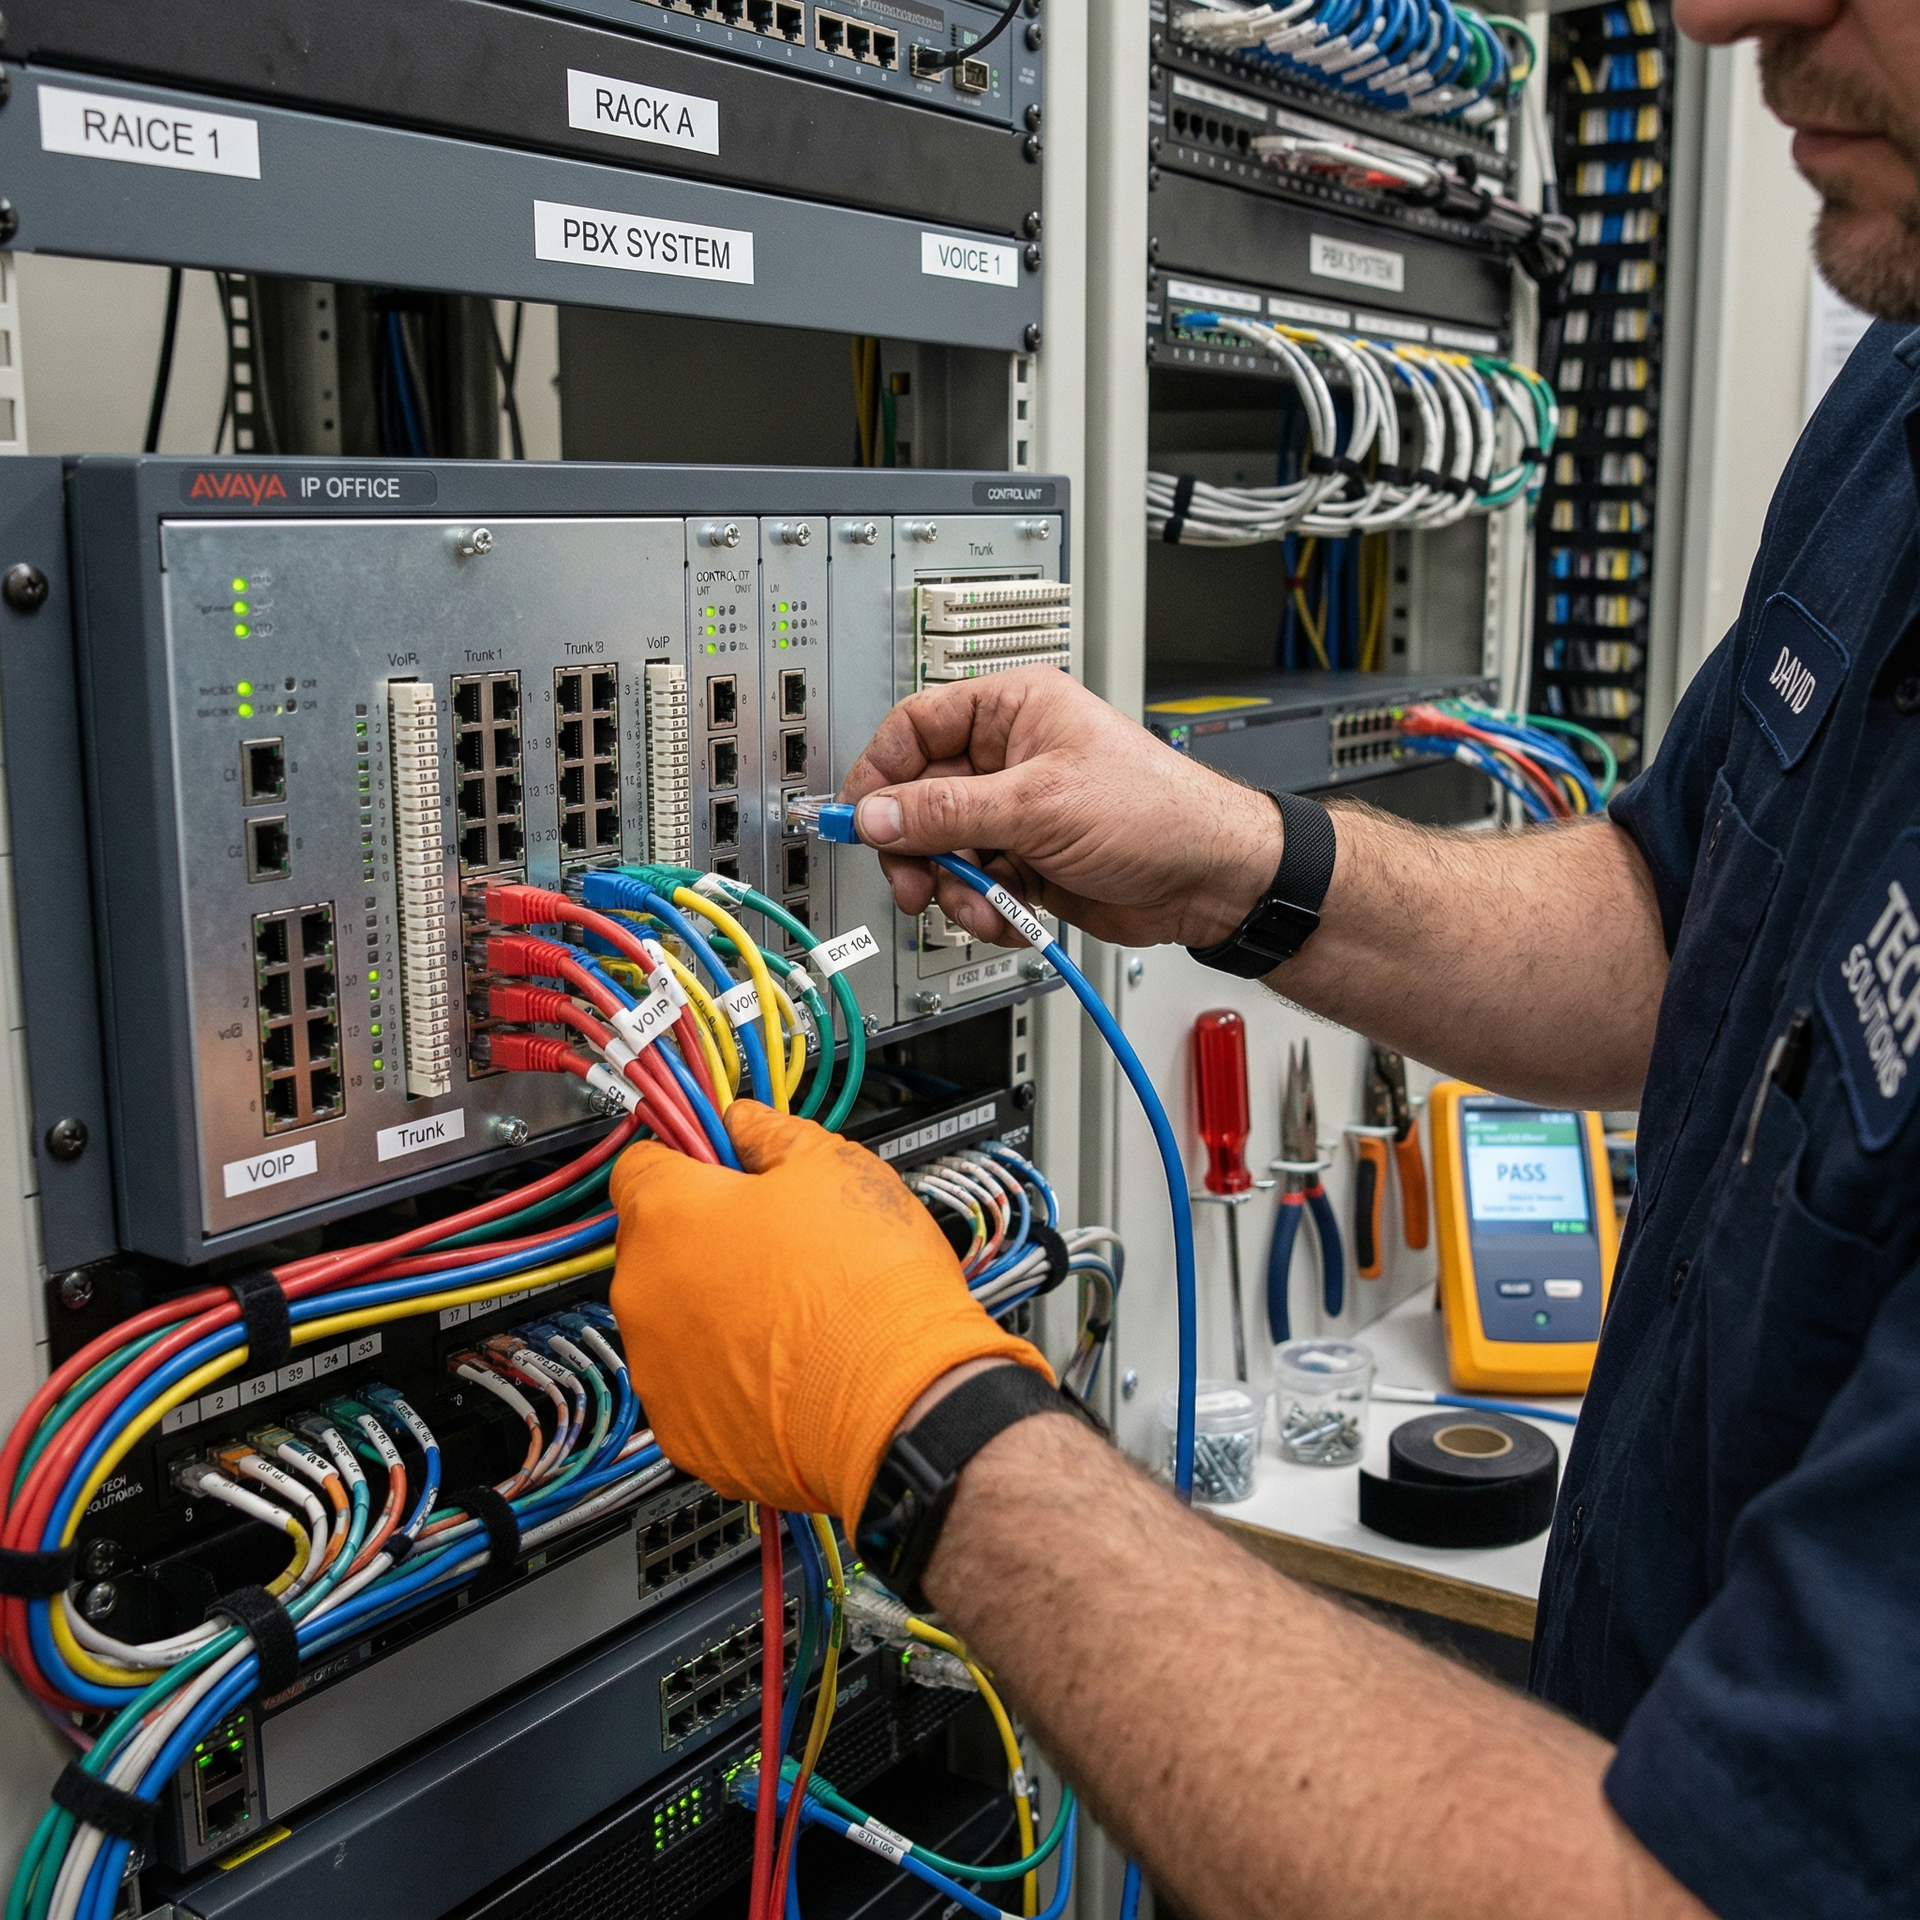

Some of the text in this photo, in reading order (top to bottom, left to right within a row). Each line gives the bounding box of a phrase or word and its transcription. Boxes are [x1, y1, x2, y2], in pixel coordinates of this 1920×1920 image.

[594, 88, 695, 138] RACK A
[83, 109, 220, 159] RAICE 1
[562, 217, 731, 271] PBX SYSTEM
[938, 244, 1002, 276] VOICE 1
[190, 472, 401, 506] AVAYA IP OFFICE
[968, 541, 994, 556] Trunk
[464, 648, 503, 663] Trunk 1
[563, 641, 595, 655] Trunk
[646, 635, 671, 649] VoIP
[1768, 645, 1817, 715] DAVID
[545, 828, 558, 841] 20
[994, 891, 1022, 920] STN
[827, 934, 872, 962] EXT 104
[632, 998, 670, 1034] VOIP
[730, 990, 760, 1014] VOIP
[398, 1120, 446, 1148] Trunk
[247, 1153, 296, 1184] VOIP
[1496, 1162, 1547, 1183] PASS
[175, 1410, 184, 1425] 1
[215, 1396, 224, 1410] 2
[250, 1381, 266, 1397] 13
